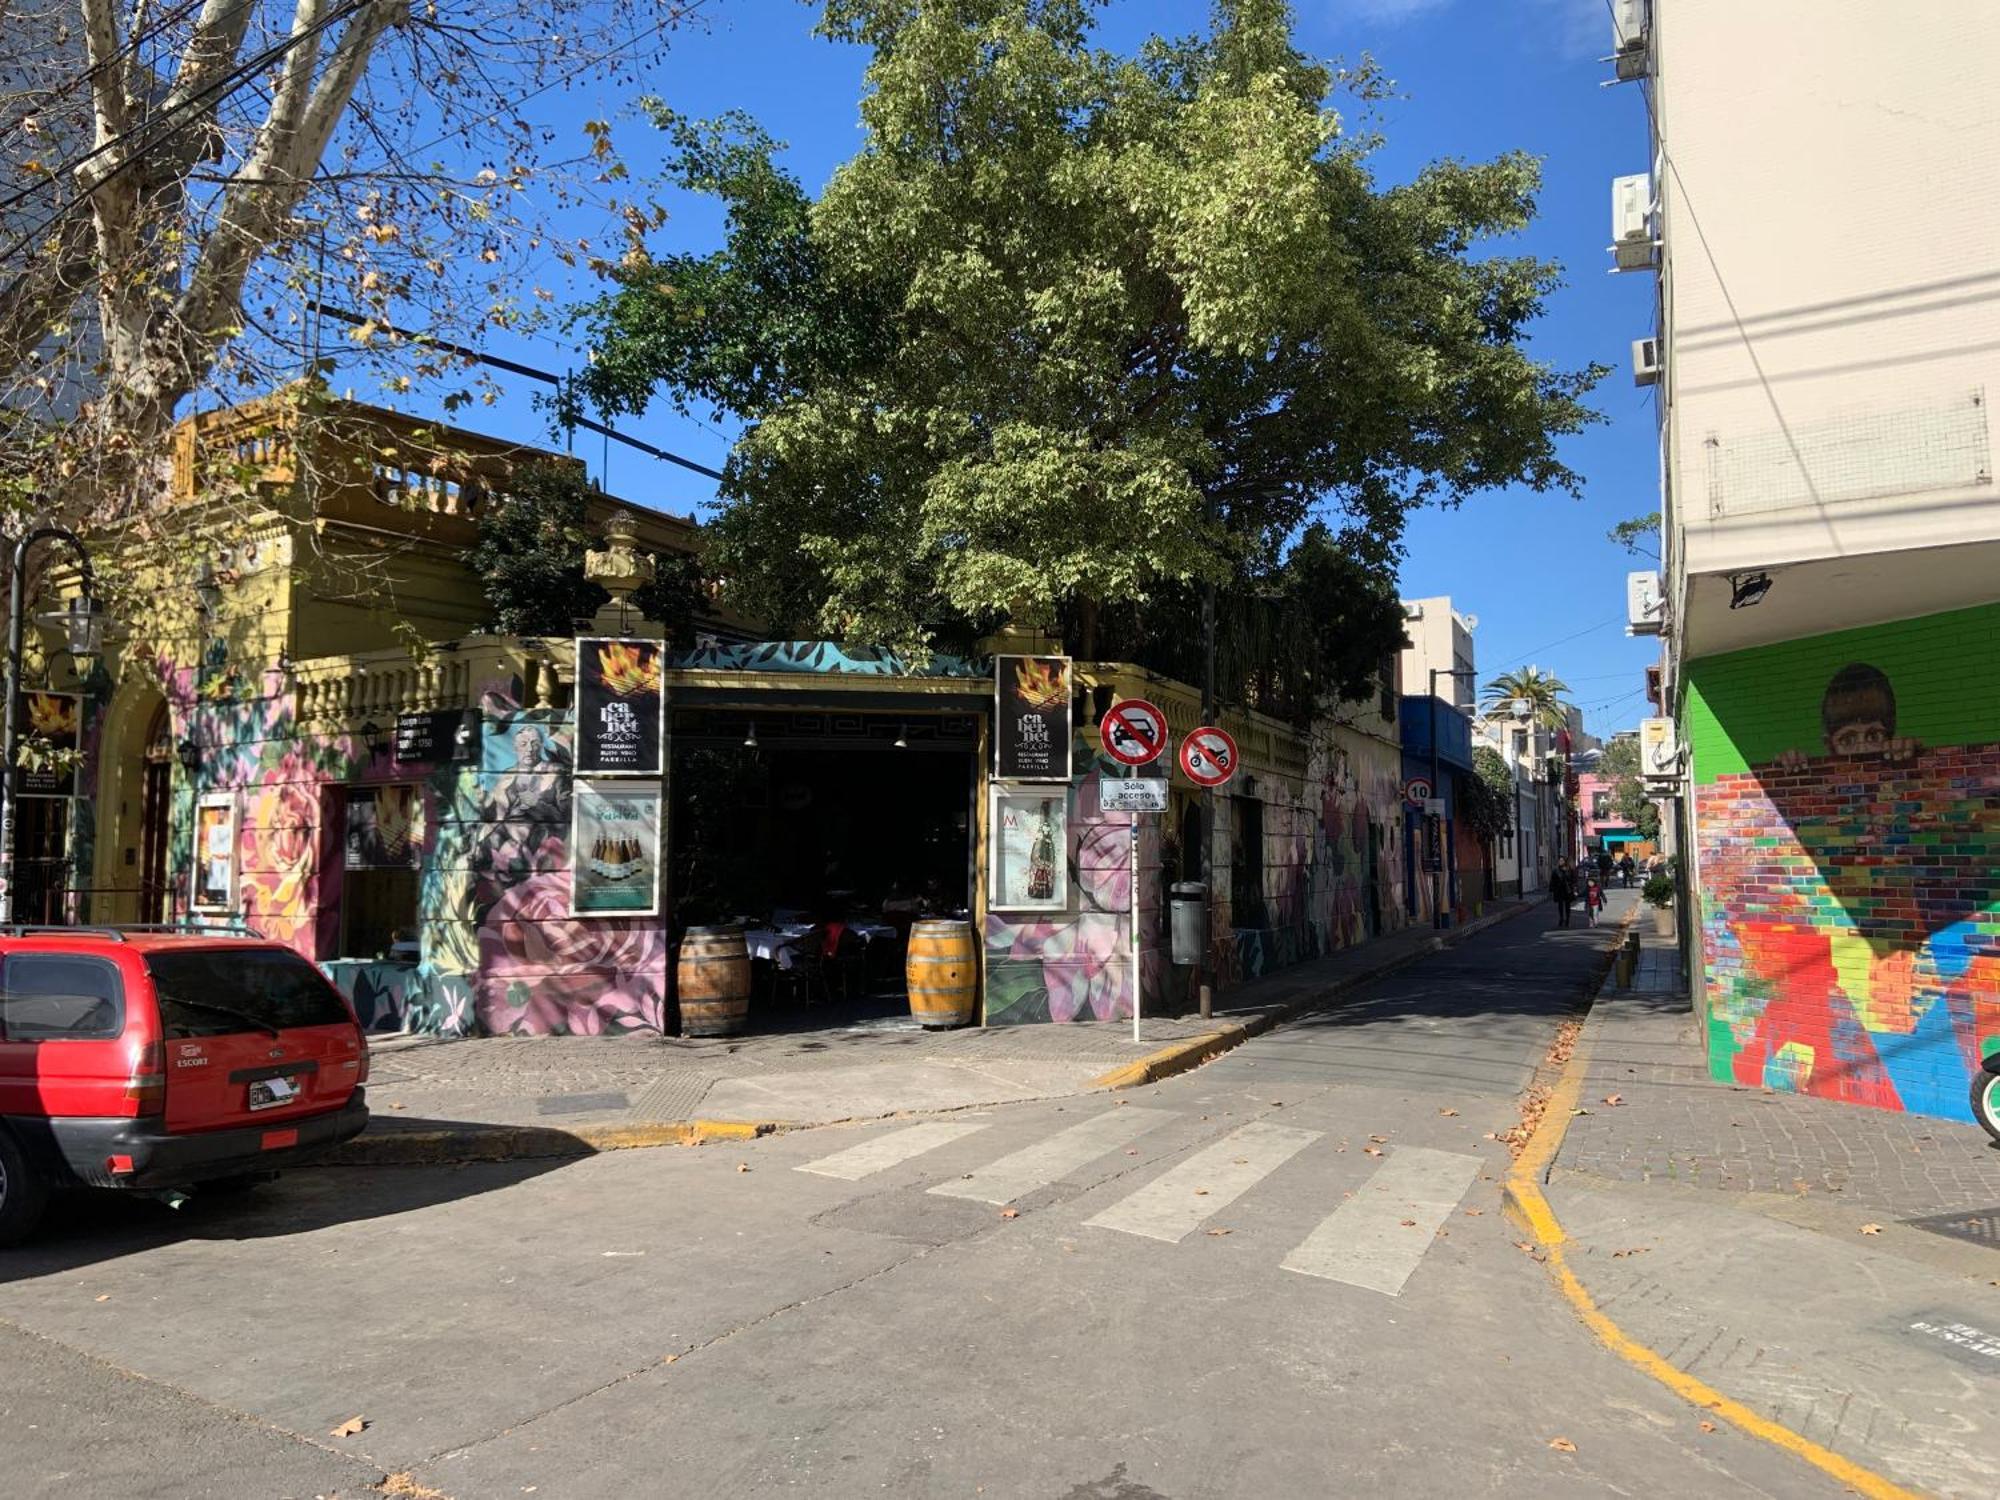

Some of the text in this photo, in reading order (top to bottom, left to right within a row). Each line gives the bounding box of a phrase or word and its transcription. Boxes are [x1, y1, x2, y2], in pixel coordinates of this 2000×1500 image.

[1118, 792, 1151, 800] acceso
[1411, 786, 1428, 798] 10
[177, 1057, 208, 1067] ESCORT
